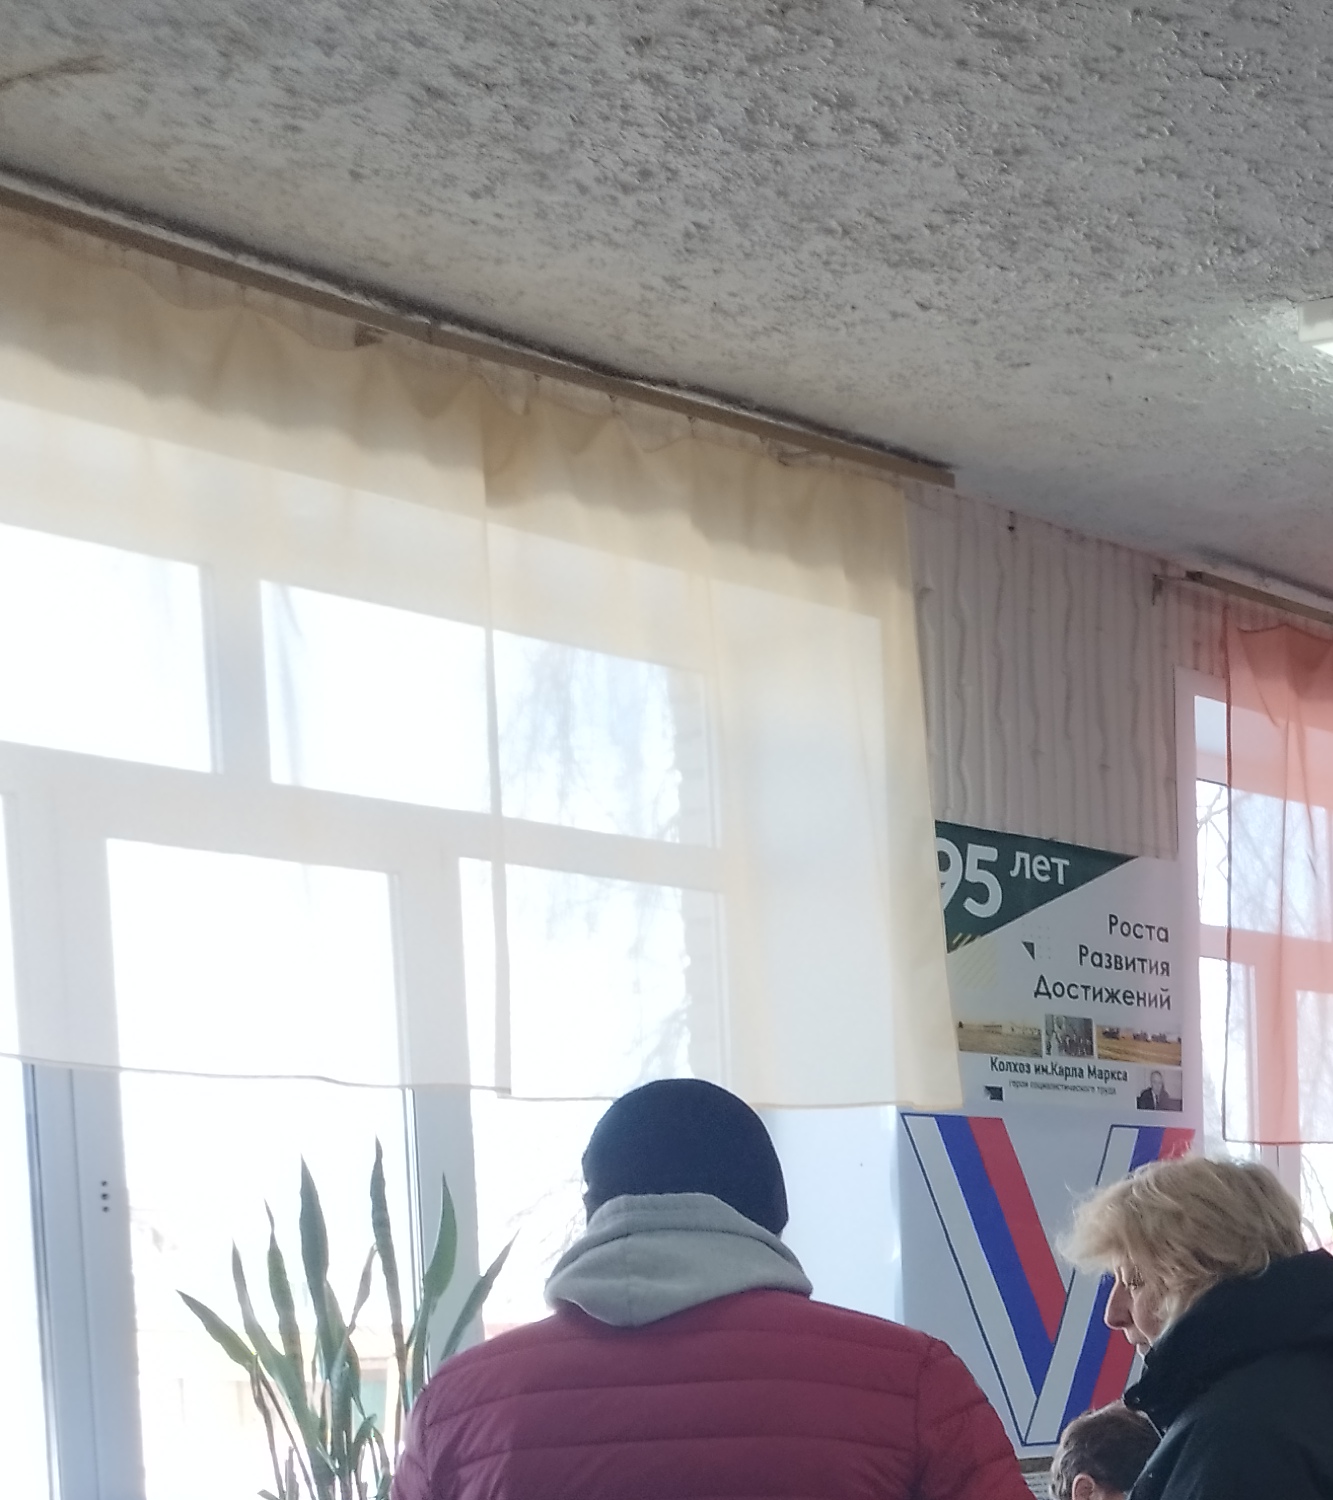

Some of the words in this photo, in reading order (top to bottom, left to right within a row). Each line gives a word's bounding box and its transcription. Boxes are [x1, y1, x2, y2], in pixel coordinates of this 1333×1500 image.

[1010, 849, 1071, 885] лет
[1107, 913, 1170, 943] Роста
[1078, 944, 1171, 977] Развития
[1033, 973, 1172, 1012] Достижений
[989, 1056, 1032, 1074] Колхоз
[1086, 1064, 1128, 1084] Маркса
